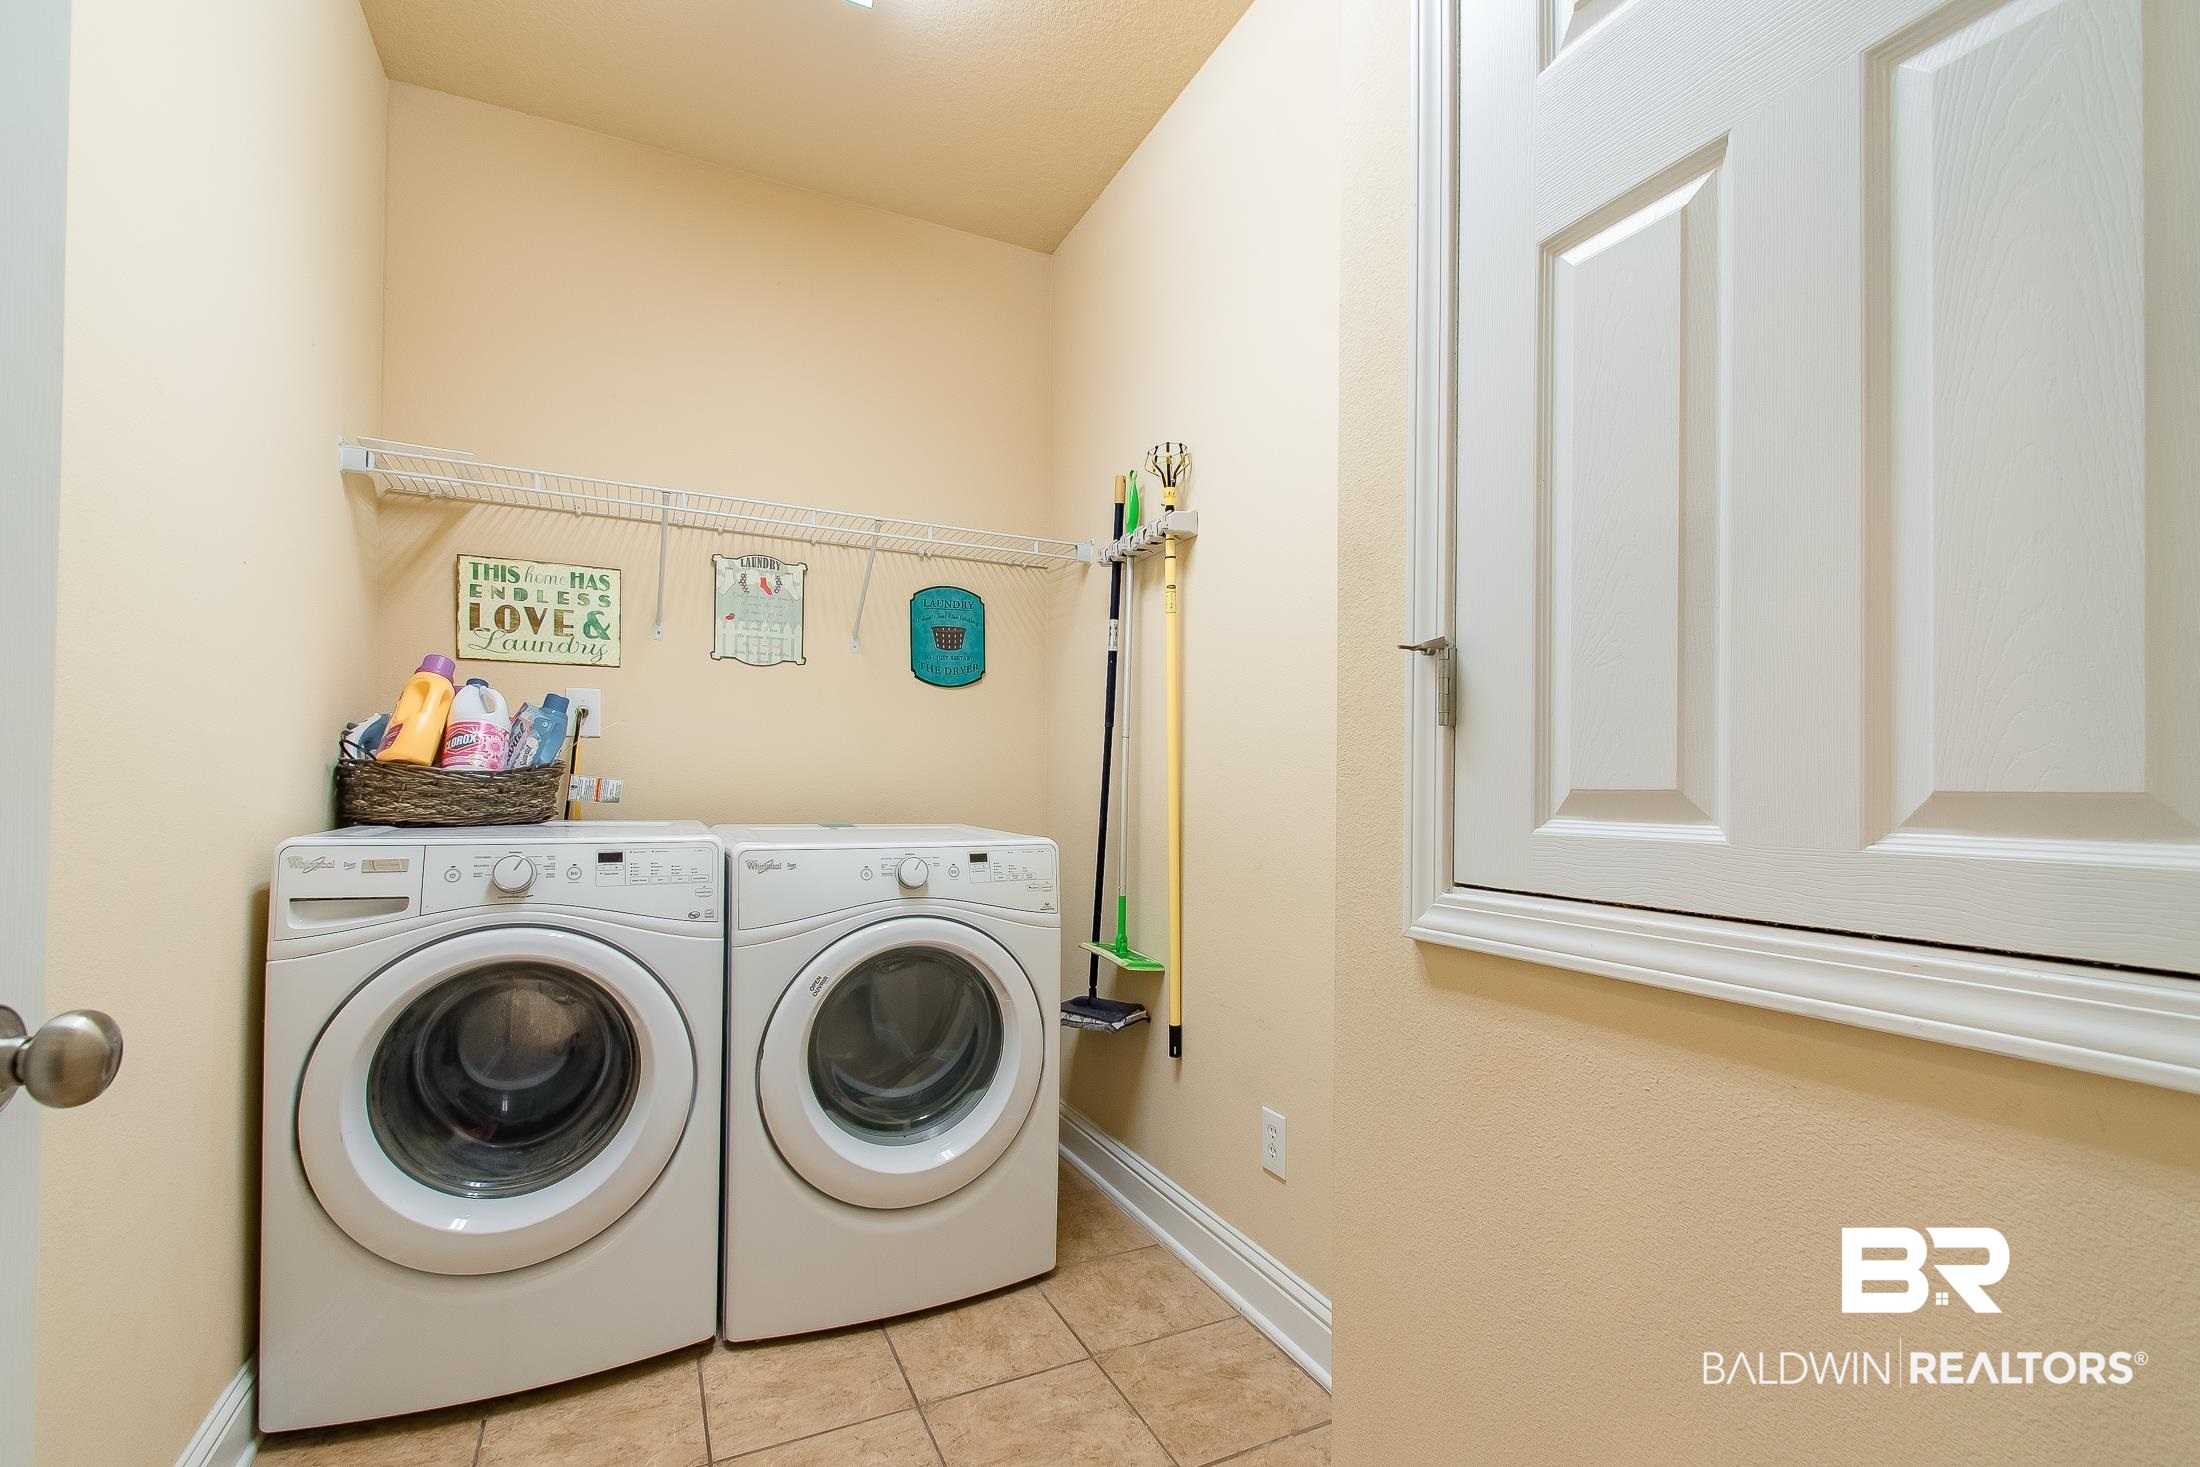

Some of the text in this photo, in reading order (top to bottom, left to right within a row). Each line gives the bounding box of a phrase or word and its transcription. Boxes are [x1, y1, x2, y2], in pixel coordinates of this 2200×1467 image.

[740, 556, 781, 571] LAUNDRY
[469, 562, 611, 592] THIS home HAS
[469, 583, 612, 609] ENDLESS
[922, 598, 975, 609] LAUNDRY
[469, 602, 612, 641] LOVE &
[468, 628, 609, 662] Laundry
[919, 660, 980, 676] THE DRYER
[287, 856, 336, 874] Whirlpool
[809, 975, 822, 992] OPEN
